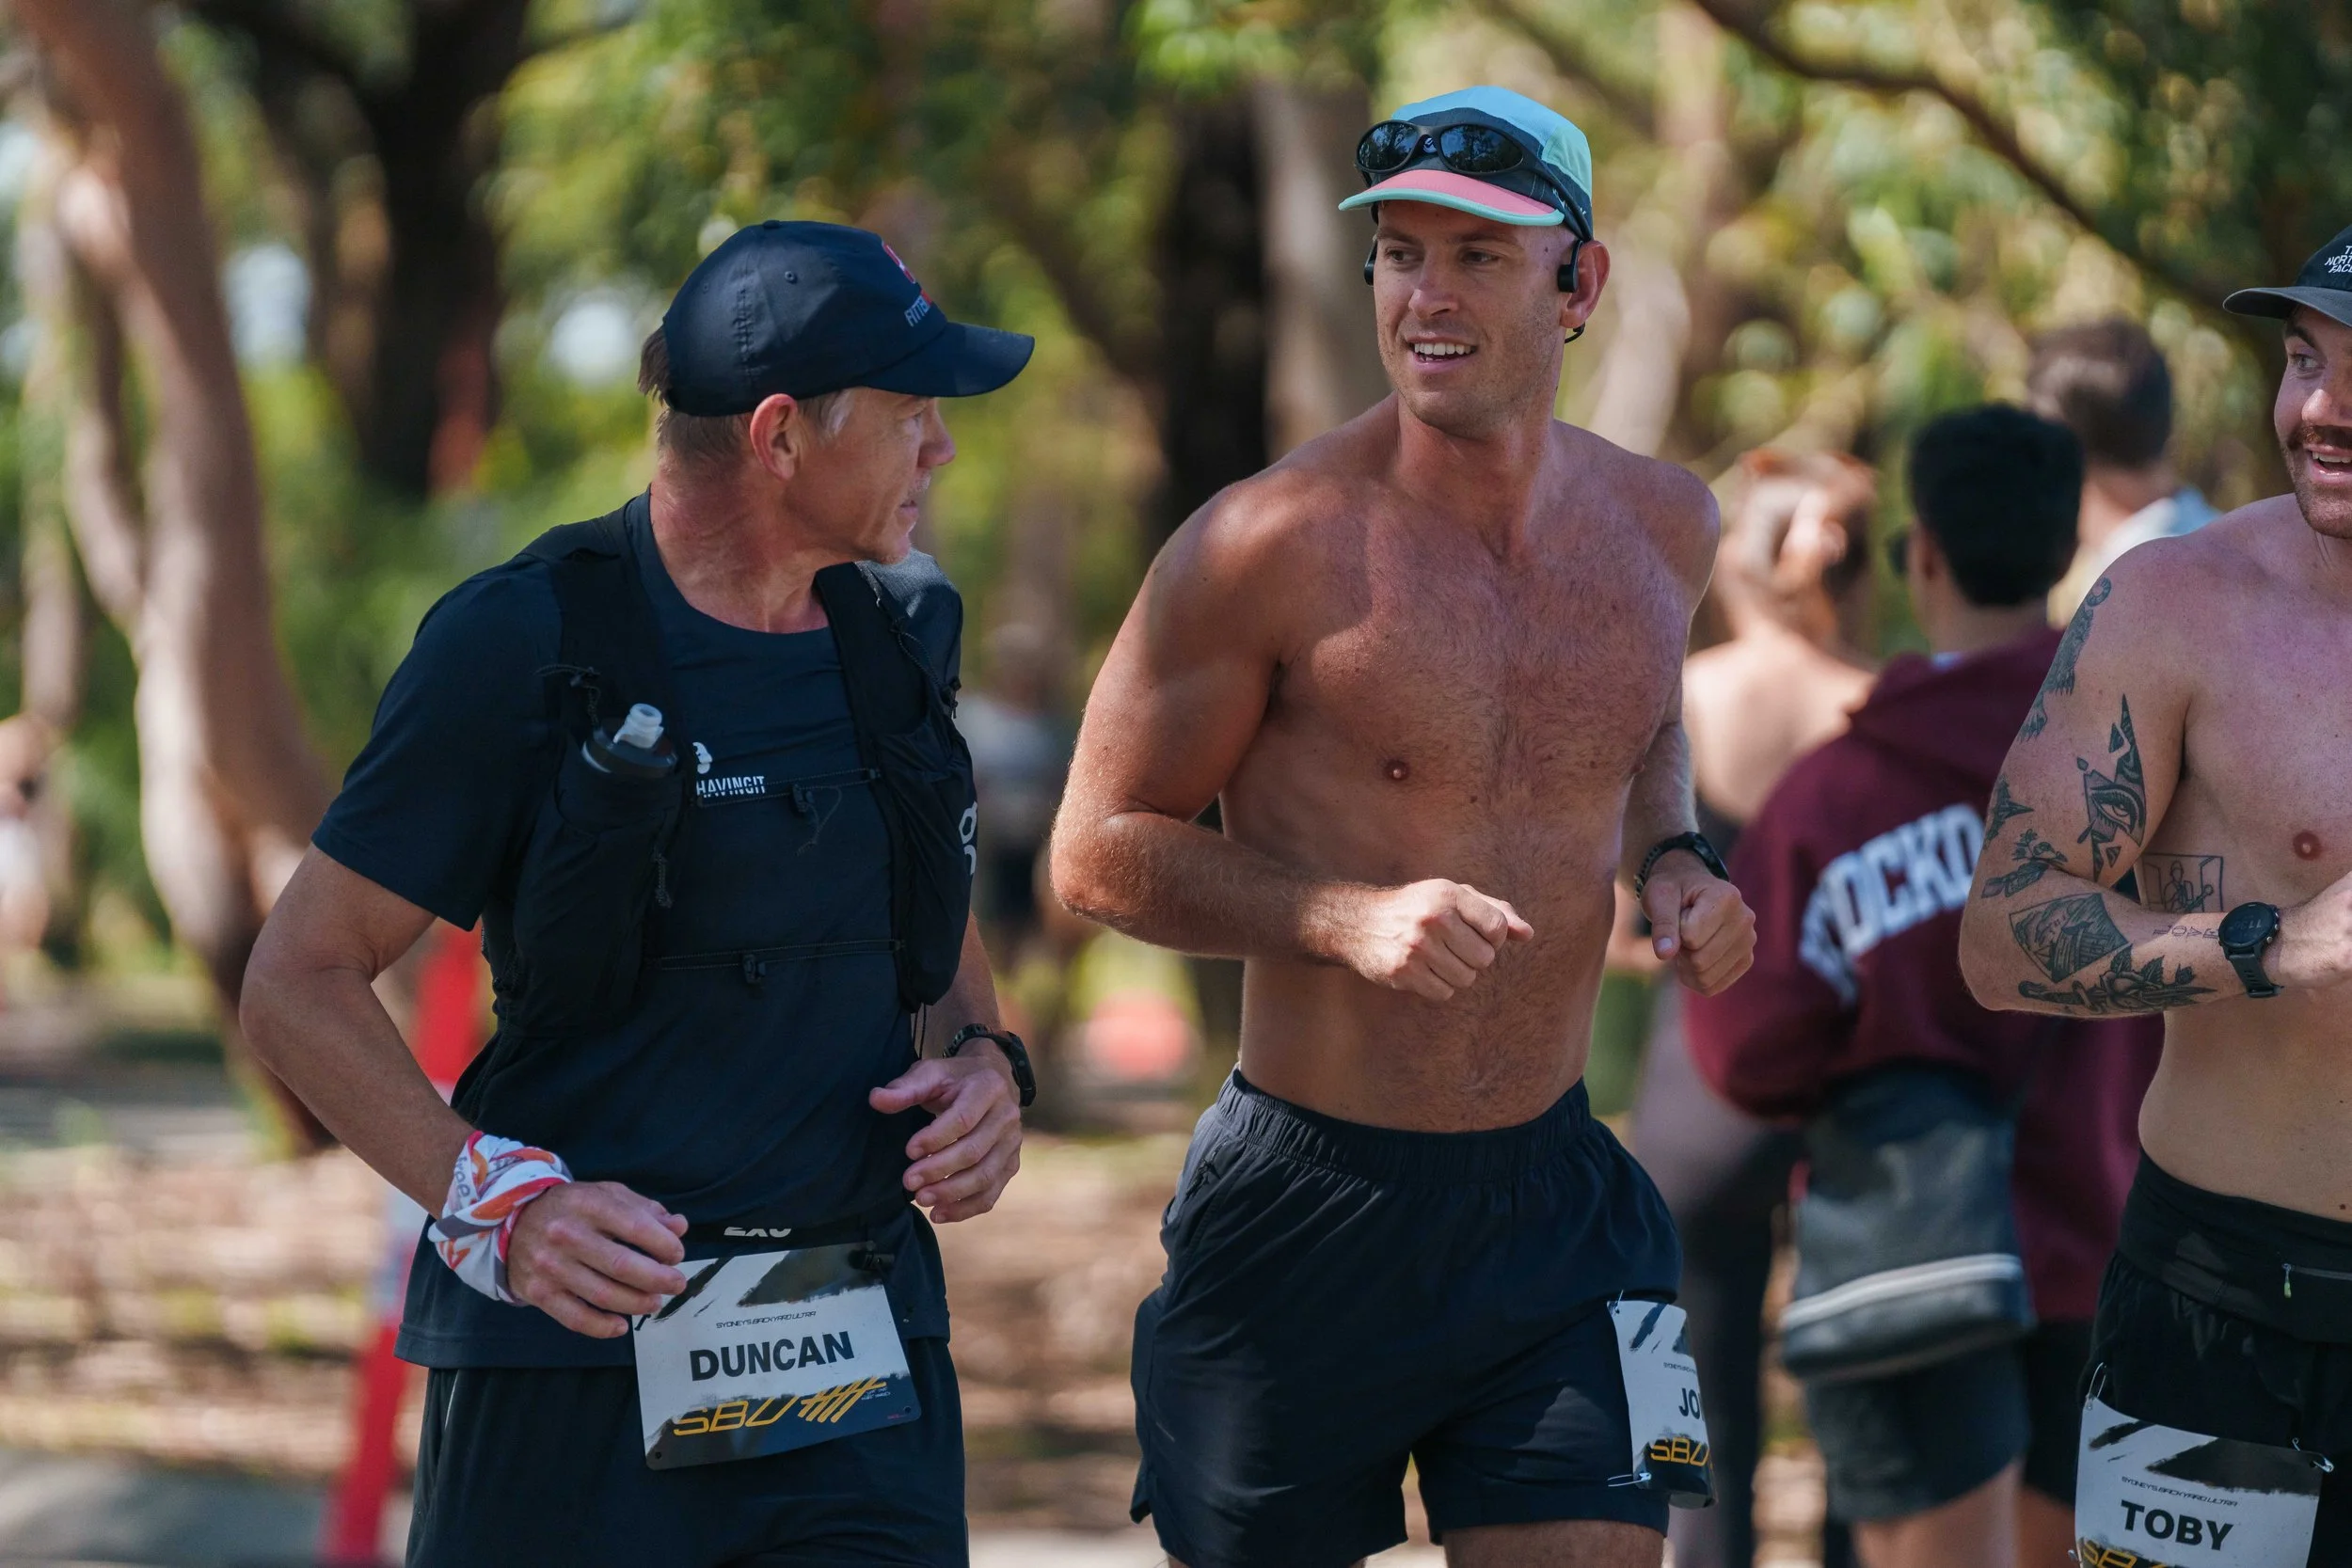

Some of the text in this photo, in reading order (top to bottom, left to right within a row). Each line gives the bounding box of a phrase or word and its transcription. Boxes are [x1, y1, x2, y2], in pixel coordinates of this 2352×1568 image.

[690, 1331, 855, 1382] DUNCAN
[673, 1394, 798, 1437] SBU
[1678, 1387, 1703, 1420] JO
[2120, 1499, 2234, 1551] TOBY
[2082, 1539, 2169, 1568] SB
